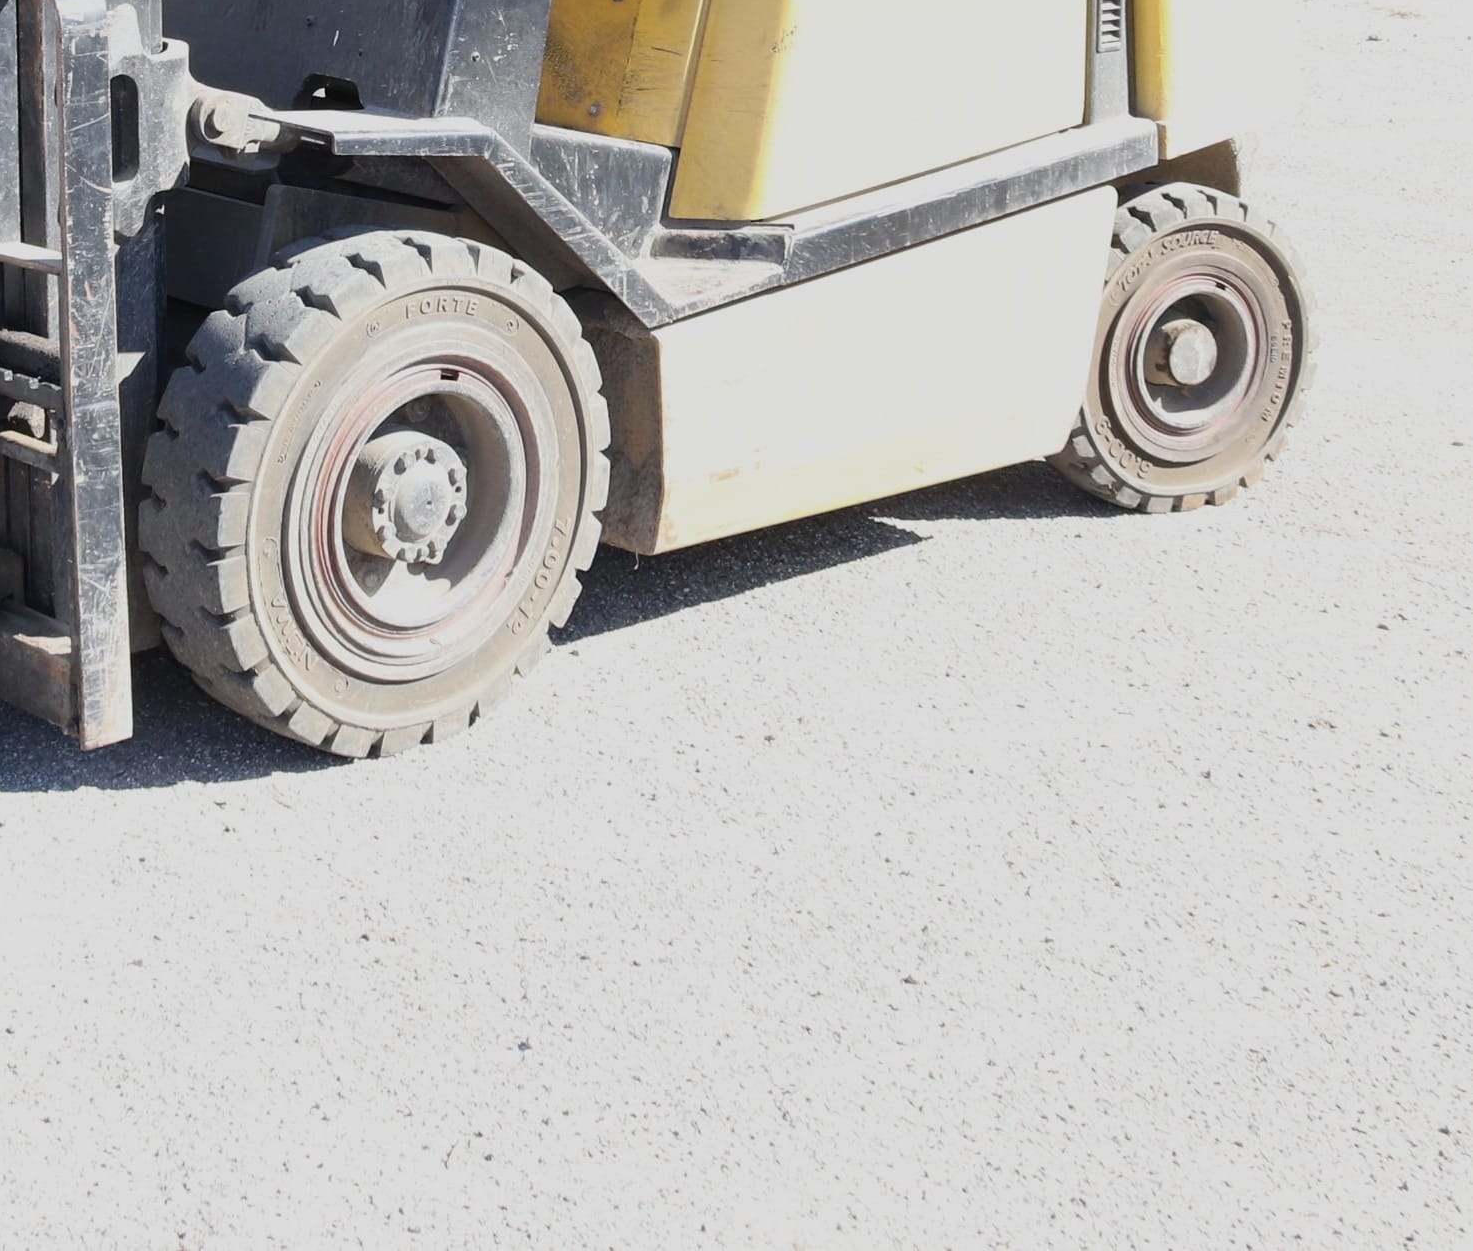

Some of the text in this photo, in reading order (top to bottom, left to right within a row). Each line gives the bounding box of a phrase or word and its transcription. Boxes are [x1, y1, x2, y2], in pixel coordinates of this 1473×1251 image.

[1160, 229, 1219, 256] SOURCE
[404, 297, 478, 320] FORTE
[1261, 318, 1293, 423] PREMIUM
